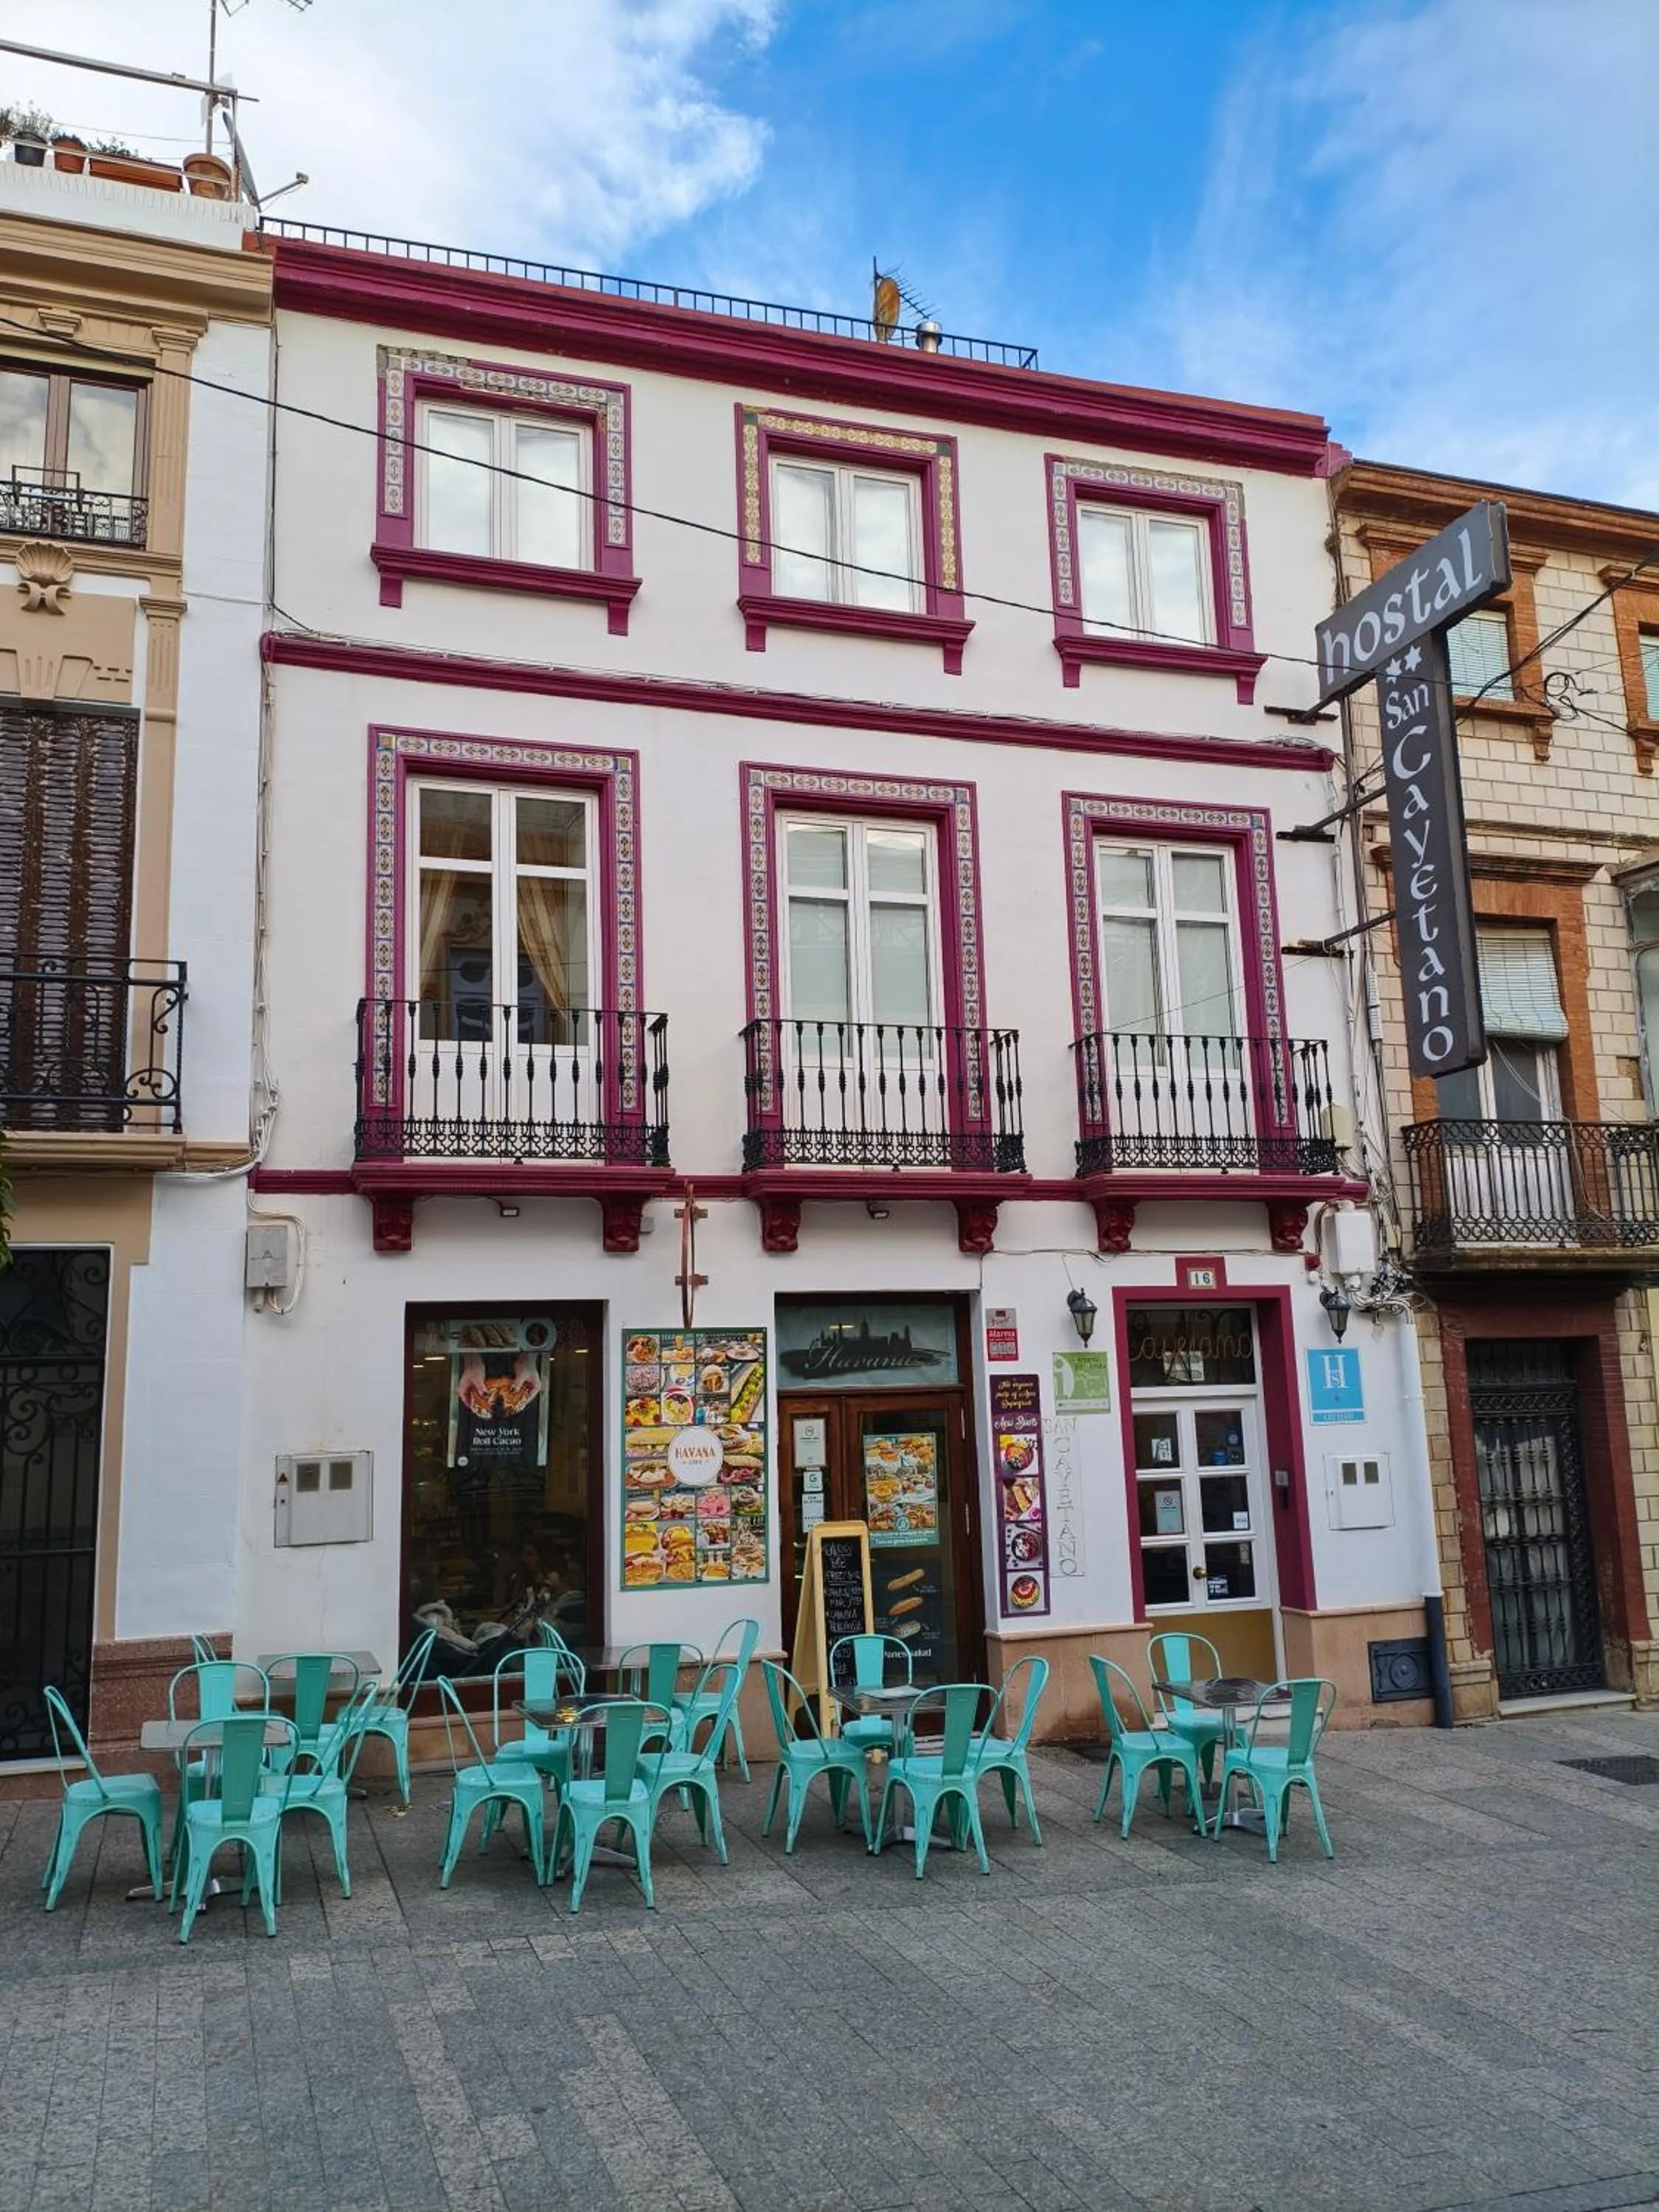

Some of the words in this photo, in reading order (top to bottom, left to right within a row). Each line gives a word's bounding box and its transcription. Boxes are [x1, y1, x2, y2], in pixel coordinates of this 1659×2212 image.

[1321, 528, 1482, 685] hostal
[1385, 680, 1430, 729] San
[1392, 725, 1453, 1062] Cayetano
[1194, 1271, 1211, 1284] 16
[804, 1338, 913, 1368] Havana
[473, 1436, 491, 1445] Roll
[492, 1436, 522, 1445] Cacao
[475, 1427, 496, 1436] New
[498, 1427, 521, 1438] York
[675, 1446, 715, 1459] HAVANA
